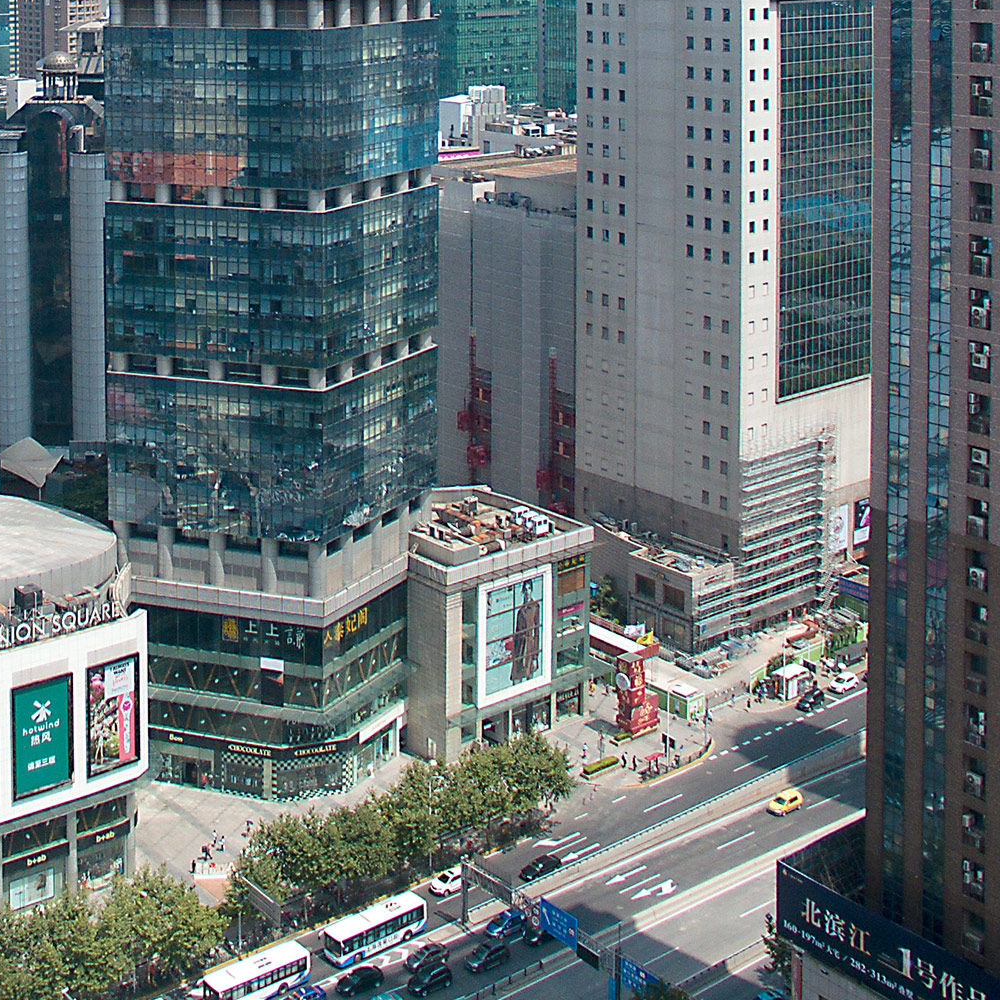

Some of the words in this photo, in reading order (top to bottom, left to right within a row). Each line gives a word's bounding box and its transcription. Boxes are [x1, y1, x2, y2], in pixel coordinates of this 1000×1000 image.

[23, 718, 60, 736] hotwind
[801, 898, 872, 957] 北滨江
